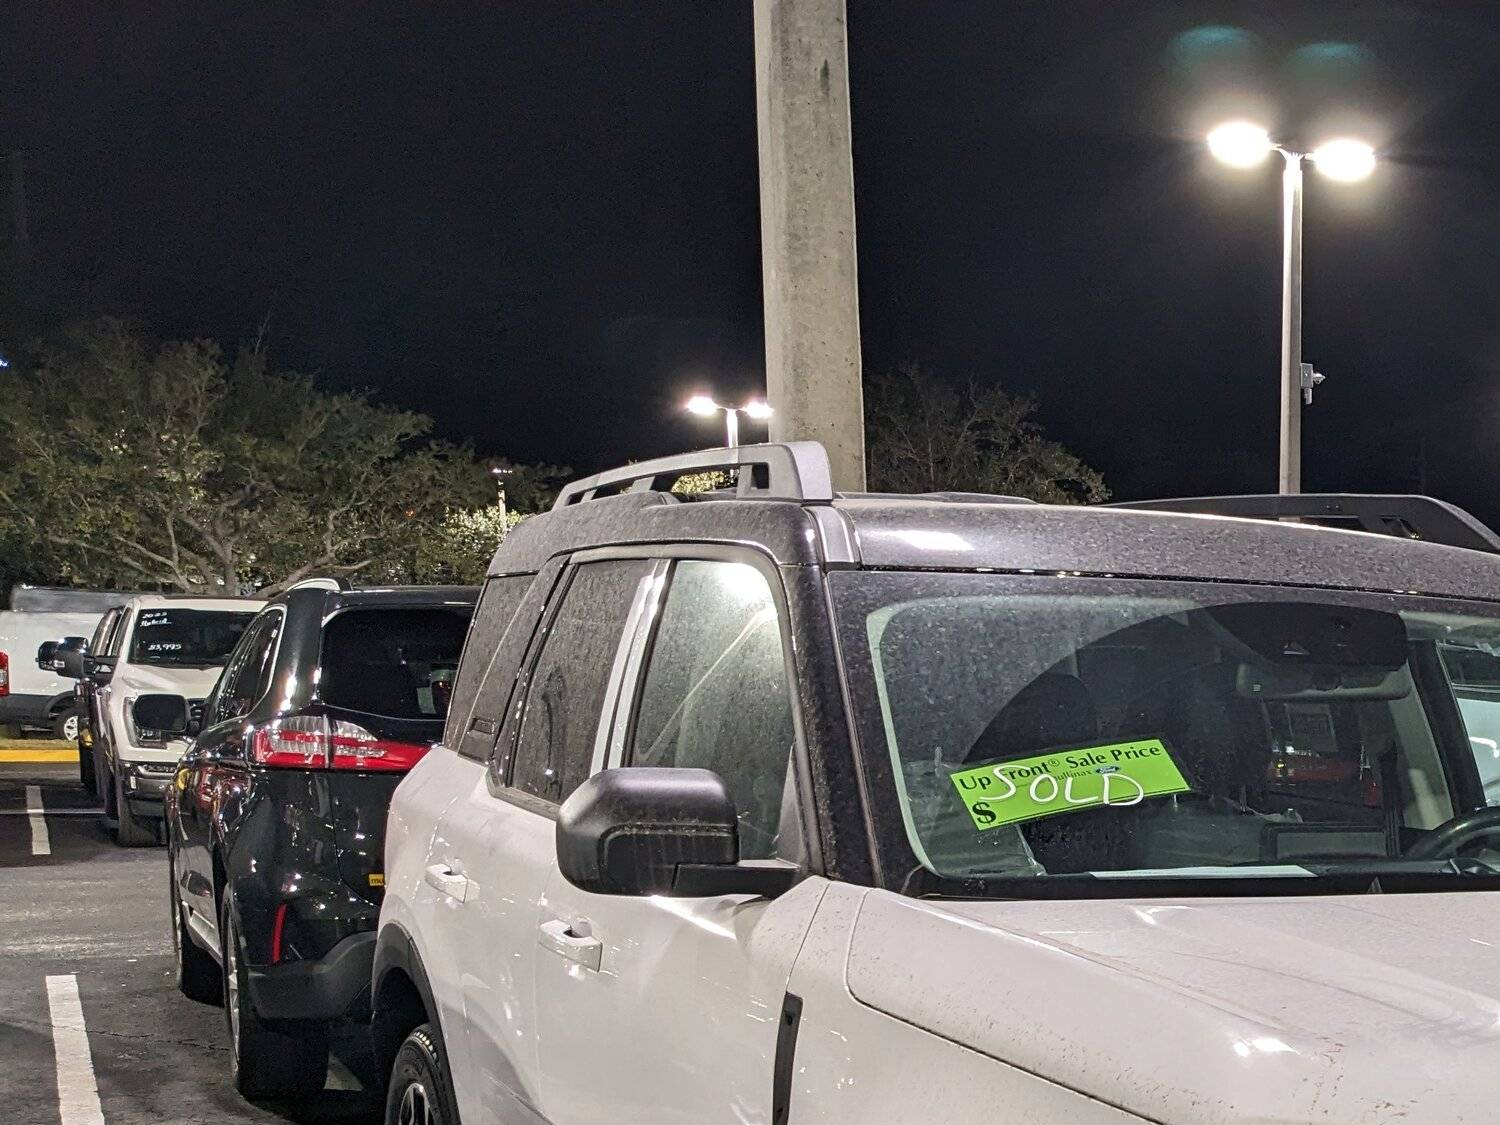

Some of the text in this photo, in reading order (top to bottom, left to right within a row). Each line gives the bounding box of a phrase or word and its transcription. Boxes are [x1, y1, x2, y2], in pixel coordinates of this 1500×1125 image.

[958, 773, 992, 791] Up
[1065, 751, 1108, 769] Sale
[1112, 745, 1162, 762] Price
[979, 764, 1144, 806] SOLD
[971, 801, 997, 826] $
